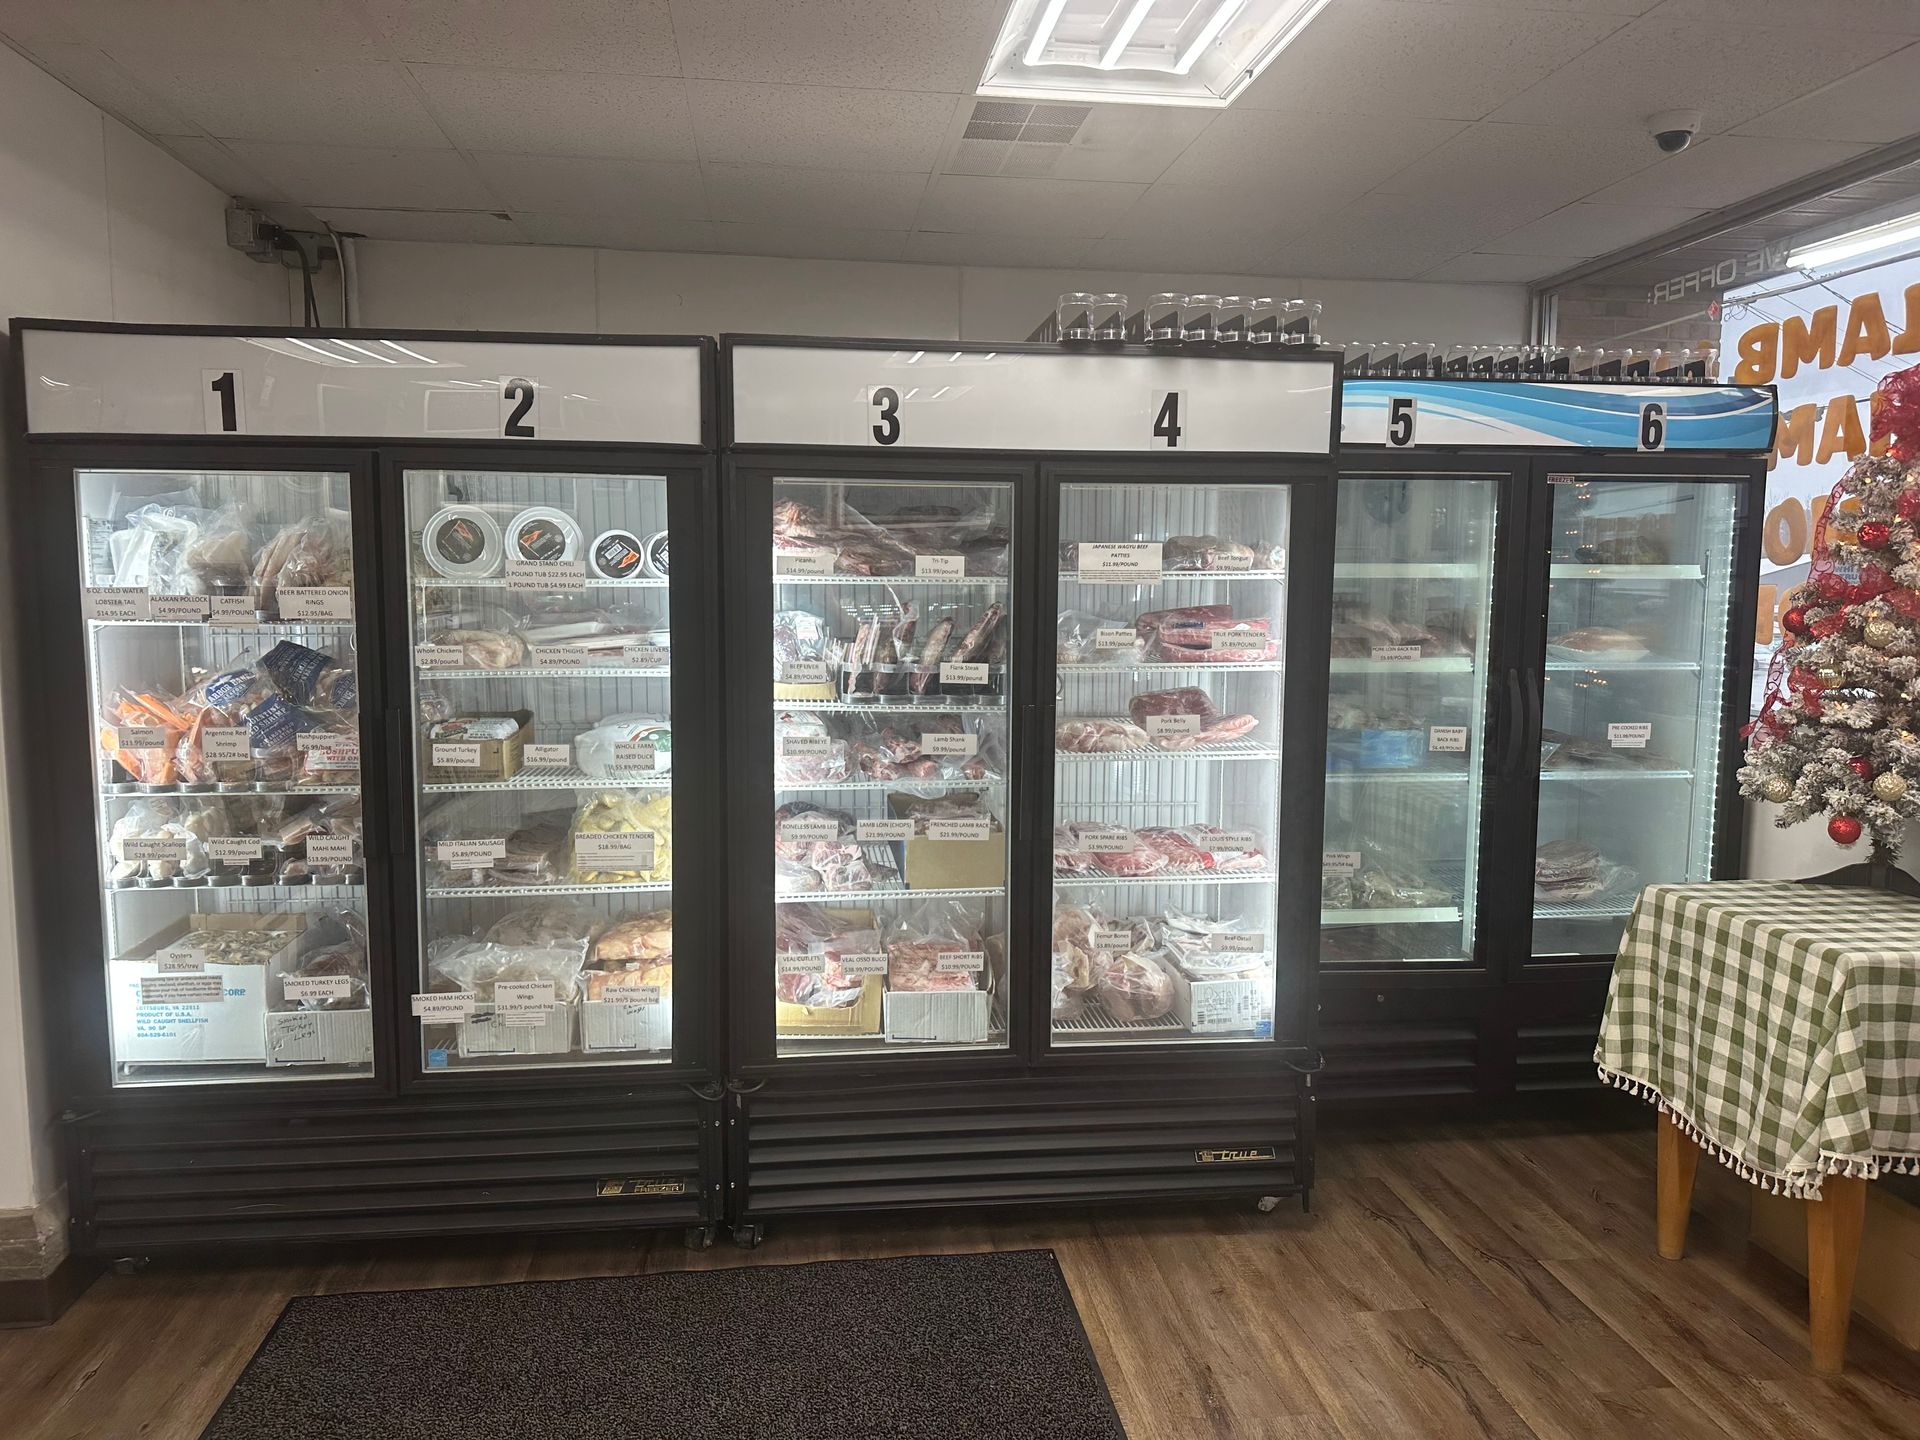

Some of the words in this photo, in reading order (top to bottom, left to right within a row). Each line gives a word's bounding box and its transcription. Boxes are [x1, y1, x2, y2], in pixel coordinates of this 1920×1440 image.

[211, 372, 237, 432] 1
[504, 377, 536, 438] 2
[872, 386, 901, 446] 3
[1153, 391, 1182, 448] 4
[1389, 398, 1414, 446] 5
[1640, 402, 1664, 450] 6
[205, 729, 234, 737] Argentine
[235, 729, 247, 737] Red
[411, 994, 438, 1002] SMOKED
[438, 994, 454, 1002] HAM
[454, 994, 474, 1002] HOCKS
